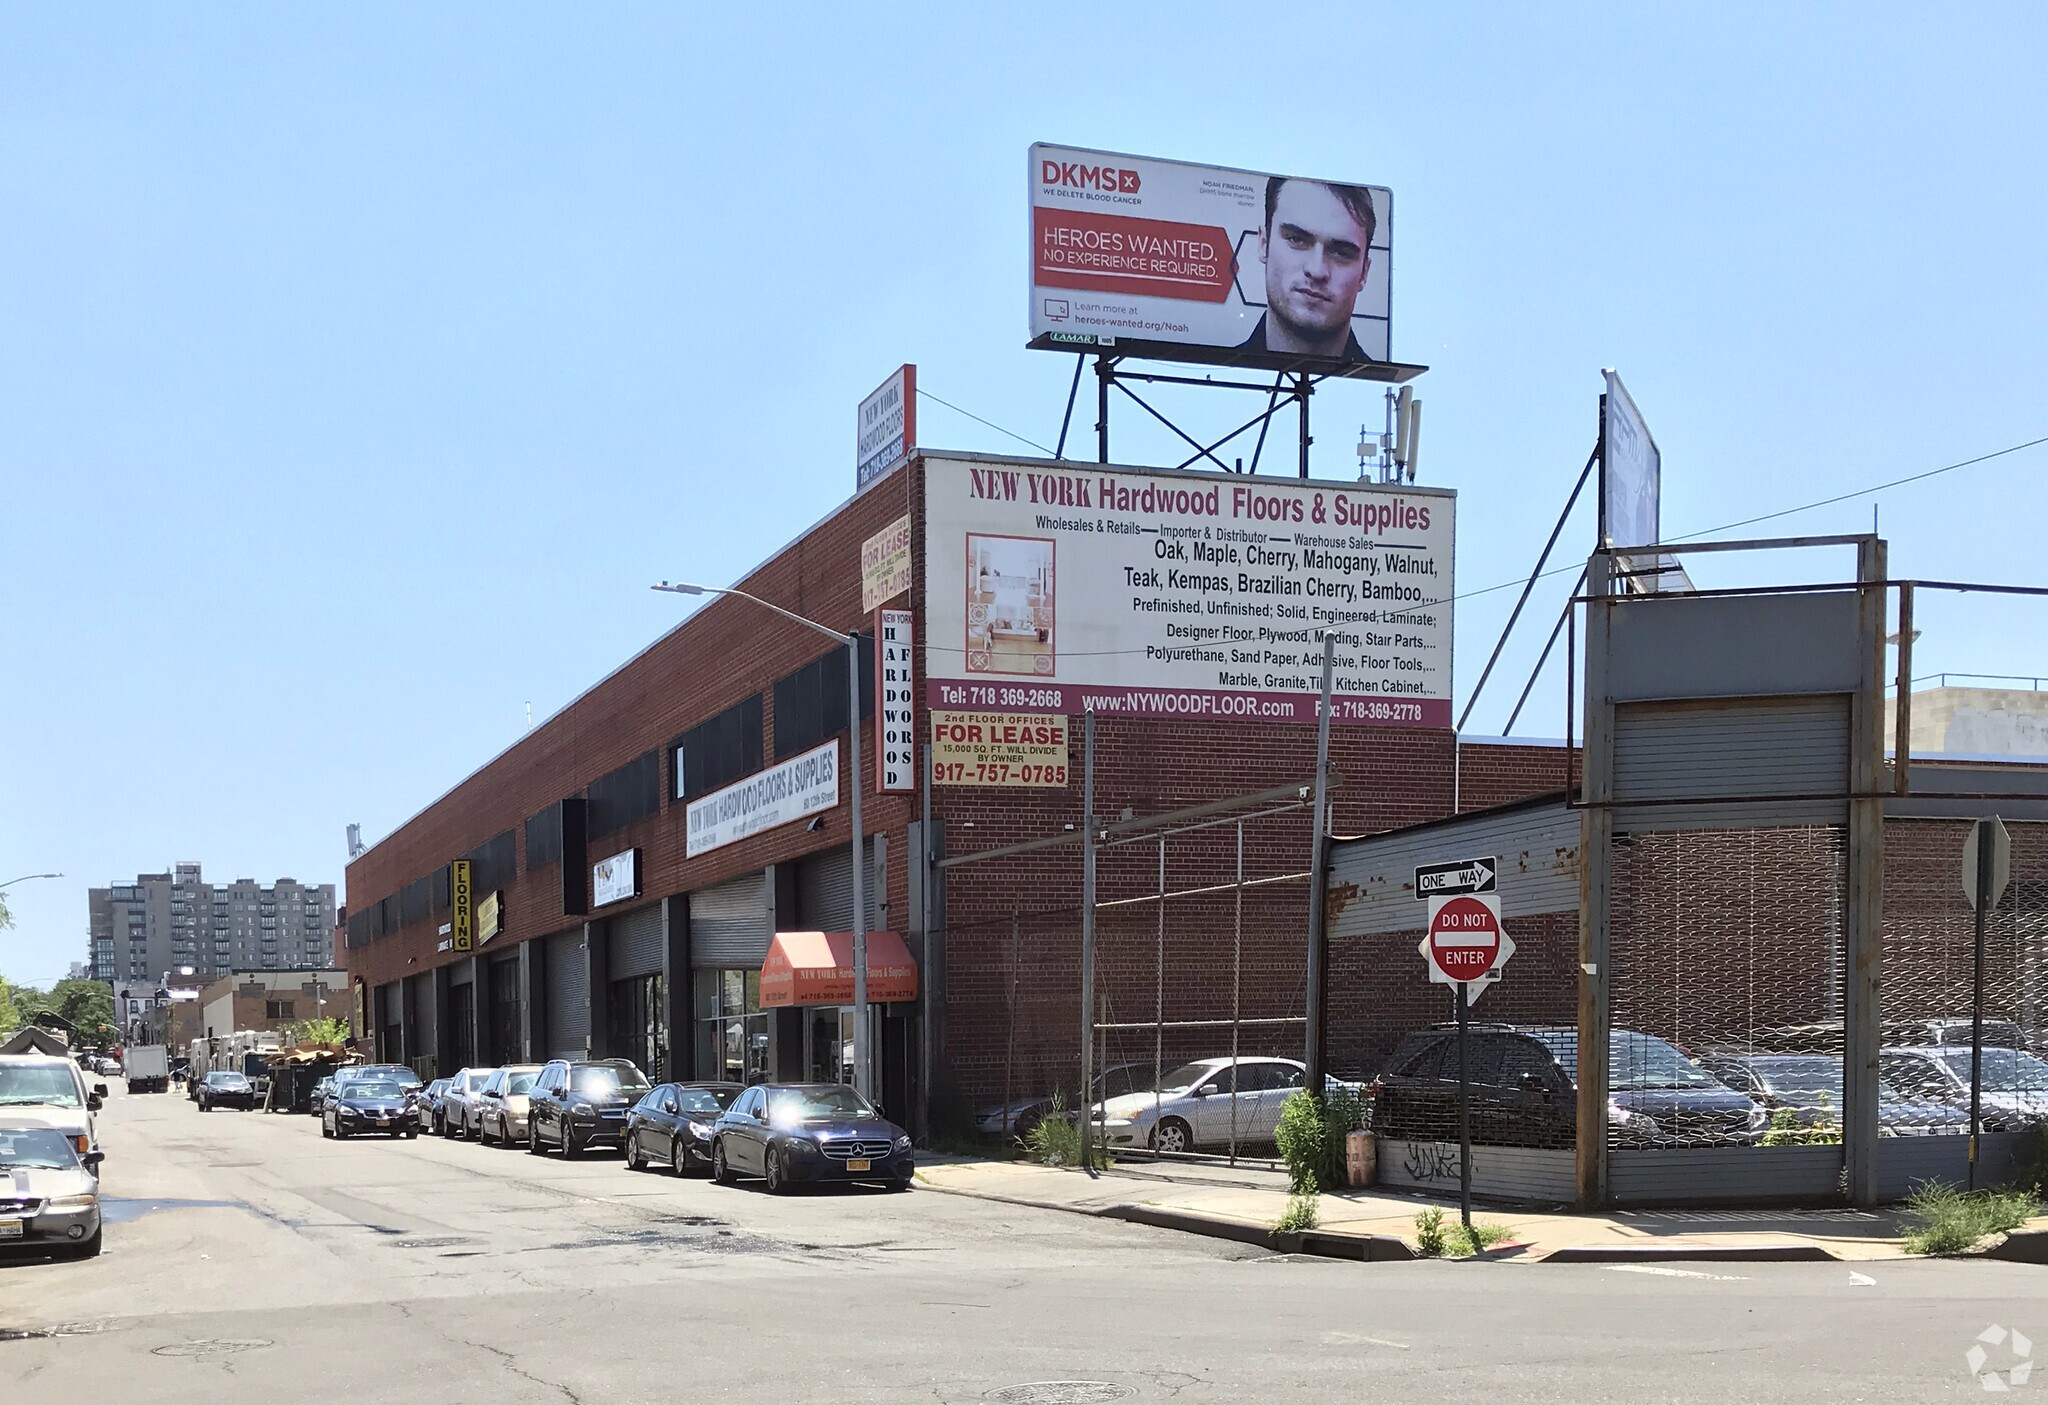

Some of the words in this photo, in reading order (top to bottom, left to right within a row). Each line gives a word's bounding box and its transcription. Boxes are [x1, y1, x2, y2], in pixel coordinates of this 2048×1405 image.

[1042, 160, 1117, 192] DKMS
[1043, 188, 1054, 196] WE
[1056, 189, 1084, 200] DELETE
[1085, 193, 1111, 202] BLOOD
[1112, 196, 1142, 205] CANCER
[1044, 227, 1123, 251] HEROES
[1127, 234, 1218, 262] WANTED.
[1043, 249, 1065, 263] NO
[1067, 251, 1147, 271] EXPERIENCE
[1150, 259, 1219, 278] REQUIRED.
[1074, 302, 1101, 312] Learn
[1102, 305, 1127, 315] more
[1128, 306, 1138, 315] at
[1074, 315, 1189, 333] heroes-wanted.org/Noah
[1053, 332, 1092, 343] LAMAR
[880, 383, 899, 416] YORK
[970, 468, 1021, 502] NEW
[1027, 473, 1092, 508] YORK
[1099, 478, 1219, 516] Hardwood
[1232, 487, 1304, 523] Floors
[1311, 492, 1327, 525] &
[1334, 494, 1431, 536] Supplies
[1035, 515, 1094, 532] Wholesales
[1096, 519, 1104, 532] &
[1160, 523, 1202, 539] Importer
[1203, 527, 1212, 540] &
[1216, 527, 1268, 544] Distributor
[1294, 532, 1347, 549] Warehouse
[1348, 536, 1374, 550] Sales
[863, 546, 879, 570] FOR
[880, 528, 909, 561] LEASE
[1154, 539, 1189, 564] Oak,
[1193, 541, 1242, 567] Maple,
[1246, 545, 1299, 572] Cherry,
[1303, 549, 1381, 576] Mahogany,
[1385, 553, 1438, 578] Walnut,
[1124, 566, 1164, 591] Teak,
[1169, 568, 1234, 596] Kempas,
[1238, 573, 1301, 596] Brazilian
[1306, 577, 1358, 603] Cherry,
[882, 613, 896, 623] NEW
[896, 614, 912, 625] YORK
[1133, 597, 1205, 615] Prefinished,
[1207, 600, 1274, 619] Unfinished;
[1276, 603, 1310, 621] Solid,
[1312, 607, 1380, 625] Engineered,
[1382, 610, 1437, 629] Laminate;
[1166, 623, 1221, 642] Designer
[1222, 625, 1257, 641] Floor,
[1259, 628, 1312, 646] Plywood,
[1365, 632, 1392, 648] Stair
[1146, 645, 1228, 665] Polyurethane,
[1231, 648, 1261, 664] Sand
[1263, 651, 1299, 669] Paper,
[1302, 652, 1358, 670] Adhsive,
[1360, 655, 1390, 669] Floor
[1218, 671, 1261, 689] Marble,
[1336, 677, 1378, 692] Kitchen
[940, 686, 967, 704] Tel:
[970, 687, 996, 705] 718
[1000, 688, 1062, 708] 369-2668
[944, 714, 965, 723] 2nd
[968, 715, 1005, 724] FLOOR
[1008, 716, 1055, 725] OFFICES
[1315, 700, 1340, 718] Fx:
[1343, 701, 1422, 721] 718-369-2778
[935, 724, 982, 743] FOR
[990, 726, 1064, 745] LEASE
[943, 744, 972, 753] 15,000
[1006, 746, 1027, 754] WILL
[1029, 747, 1057, 755] DIVIDE
[977, 754, 989, 762] BY
[991, 754, 1024, 763] OWNER
[758, 769, 787, 808] FLOORS
[788, 766, 793, 797] &
[795, 750, 833, 794] SUPPLIES
[934, 762, 1066, 784] 917-757-0785
[1422, 874, 1446, 889] ONE
[1458, 868, 1485, 885] WAY
[457, 862, 469, 948] FLOORING
[1442, 914, 1459, 927] DO
[1464, 913, 1488, 927] NOT
[1446, 951, 1485, 965] ENTER
[800, 969, 815, 979] NEW
[816, 969, 837, 979] YORK
